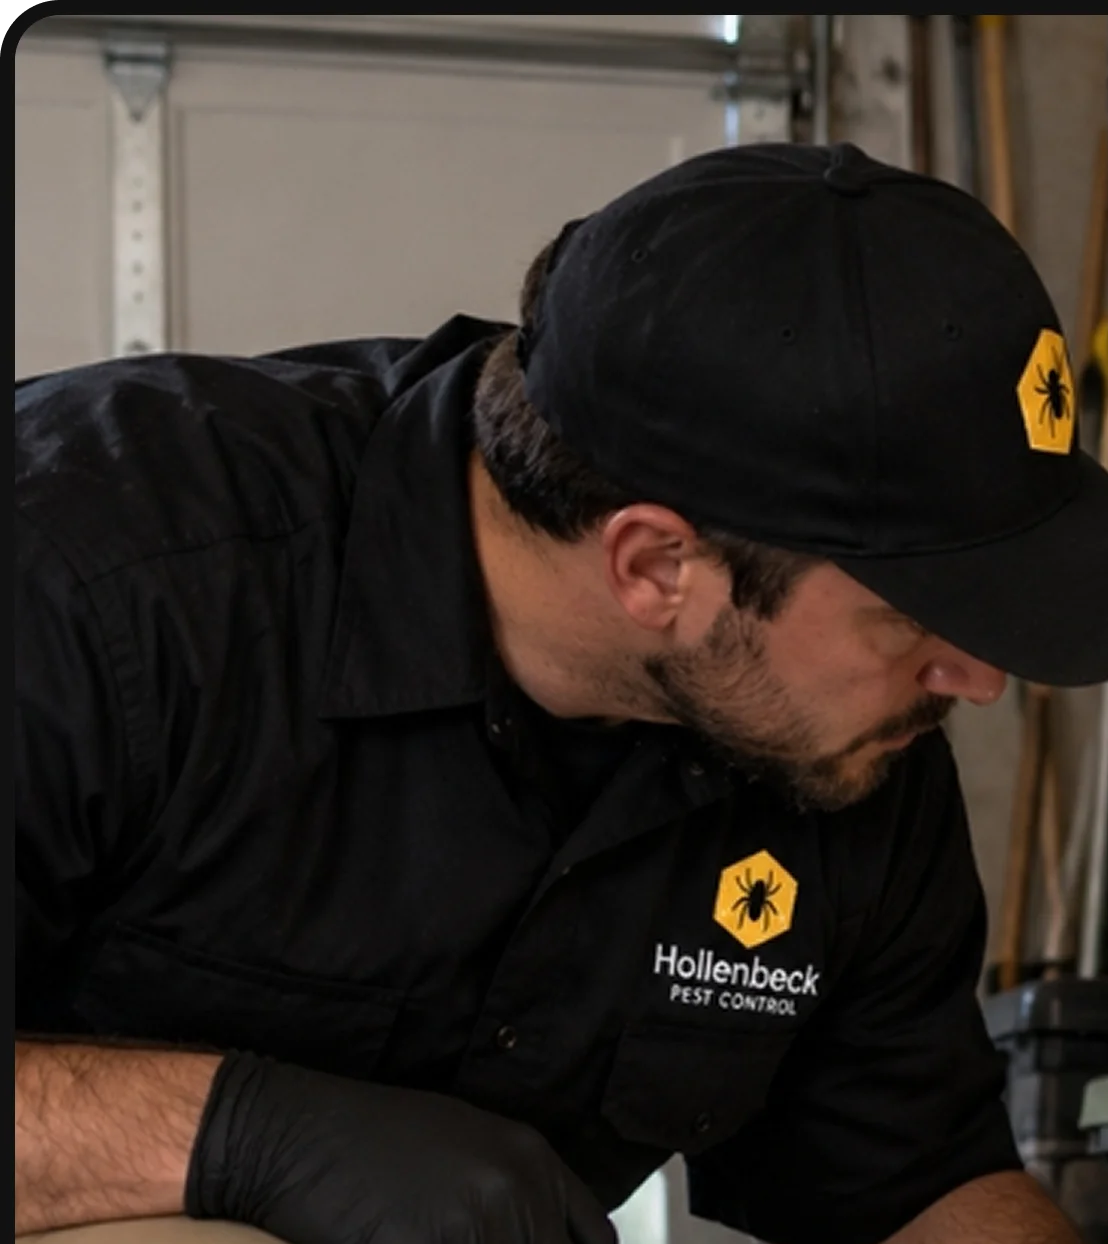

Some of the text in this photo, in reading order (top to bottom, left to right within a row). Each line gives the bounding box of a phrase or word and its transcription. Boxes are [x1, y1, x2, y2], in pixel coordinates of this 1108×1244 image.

[654, 943, 819, 994] Hollenbeck
[670, 984, 796, 1016] PEST CONTROL
